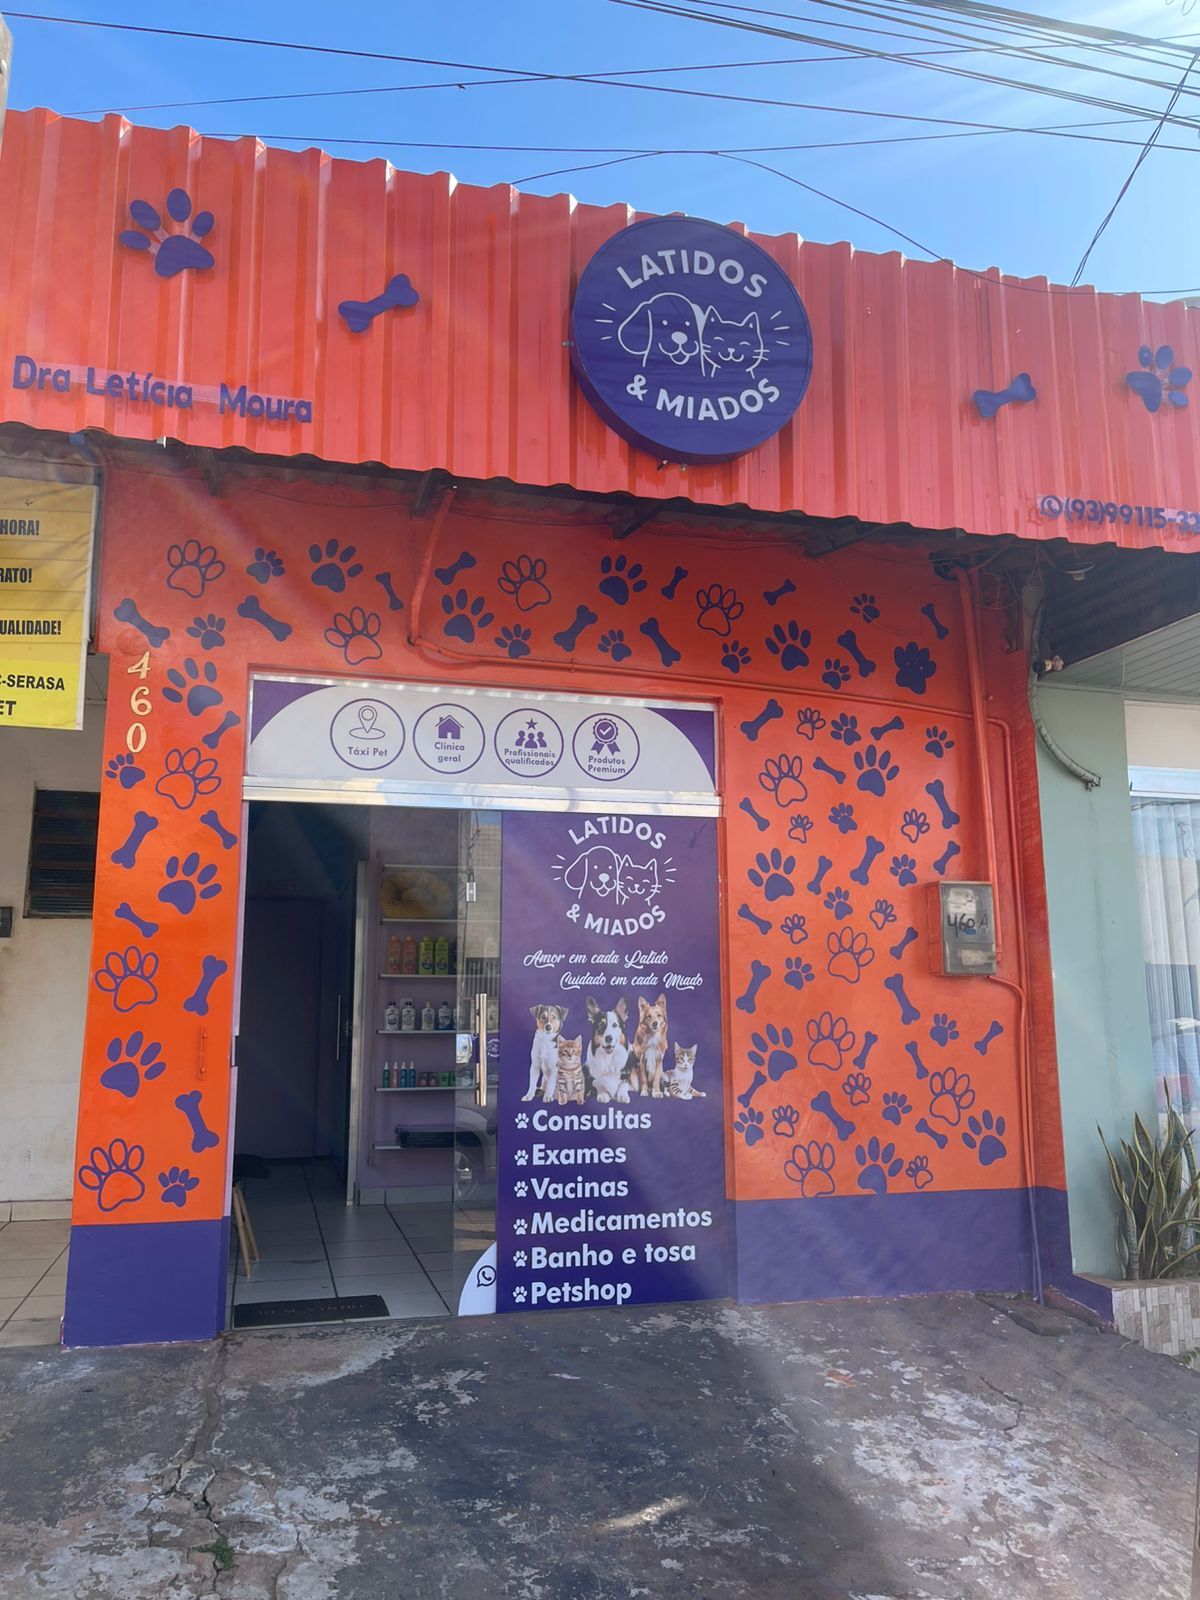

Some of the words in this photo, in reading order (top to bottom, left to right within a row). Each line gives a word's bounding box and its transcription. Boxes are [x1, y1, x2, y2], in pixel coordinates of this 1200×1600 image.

[617, 249, 768, 298] LATIDOS
[12, 355, 71, 393] Dra
[219, 382, 312, 423] Moura
[626, 374, 648, 401] &
[656, 378, 780, 421] MIADOS
[0, 519, 40, 536] HORA!
[0, 674, 65, 691] -SERASA
[373, 748, 388, 757] Pet
[437, 754, 461, 763] geral
[503, 748, 556, 758] Profissionais
[505, 757, 555, 767] qualificados
[588, 755, 626, 765] Produtos
[588, 764, 626, 774] Premium
[568, 816, 667, 850] LATIDOS
[566, 903, 581, 923] &
[584, 905, 666, 936] MIADOS
[523, 949, 565, 969] Amor
[568, 954, 588, 965] em
[591, 951, 620, 965] cada
[624, 950, 669, 969] Latido
[560, 971, 607, 990] Cuidado
[610, 976, 628, 986] em
[631, 973, 659, 986] cada
[662, 972, 704, 990] Miado
[532, 1107, 652, 1132] Consultas
[532, 1143, 627, 1166] Exames
[530, 1175, 629, 1199] Vacinas
[530, 1208, 713, 1235] Medicamentos
[531, 1243, 614, 1269] Banho
[621, 1247, 637, 1264] e
[644, 1243, 696, 1263] tosa
[530, 1277, 632, 1305] Petshop
